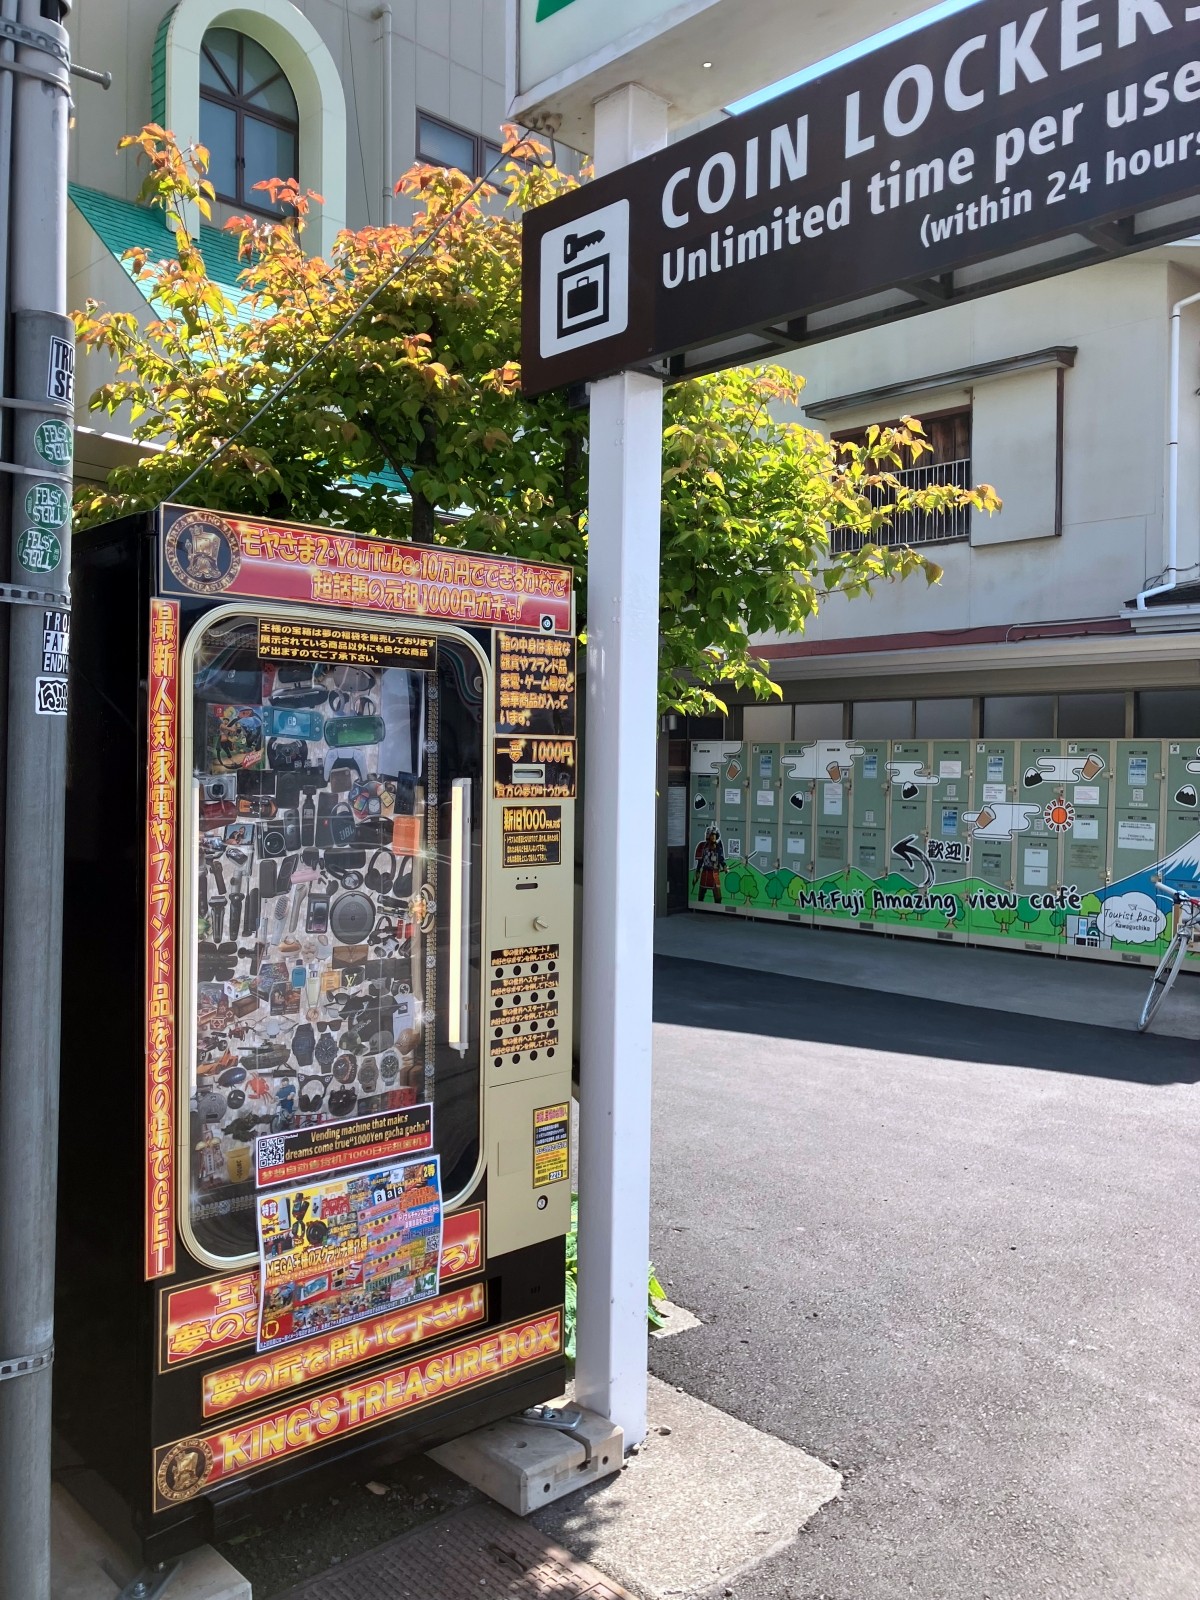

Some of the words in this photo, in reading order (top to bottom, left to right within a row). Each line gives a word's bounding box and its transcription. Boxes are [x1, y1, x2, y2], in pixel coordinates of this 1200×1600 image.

[661, 114, 809, 229] COIN
[845, 0, 1200, 159] LOCKER
[662, 179, 850, 289] Unlimited
[867, 147, 975, 215] time
[995, 102, 1084, 184] per
[920, 186, 1032, 248] (within
[1046, 162, 1091, 204] 24
[259, 645, 380, 664] が出ますのでご了承下さい。
[260, 634, 429, 658] 展示されている商品以外にも色々な商品
[531, 741, 574, 764] 1000円
[800, 889, 865, 916] Mt.Fuji
[873, 889, 957, 917] Amazing
[968, 889, 1018, 910] view
[1029, 886, 1082, 910] café
[1105, 908, 1134, 920] Tourist
[1136, 911, 1160, 923] Base
[149, 602, 176, 1274] 最新人気家電やブランド品をその場でGET
[285, 1145, 313, 1161] dreams
[314, 1141, 334, 1155] come
[384, 1126, 404, 1142] gacha
[311, 1129, 341, 1143] Vending
[341, 1122, 371, 1136] machine
[372, 1118, 387, 1130] that
[222, 1395, 341, 1473] KING'S
[346, 1337, 499, 1424] TREASURE
[499, 1316, 558, 1365] BOX
